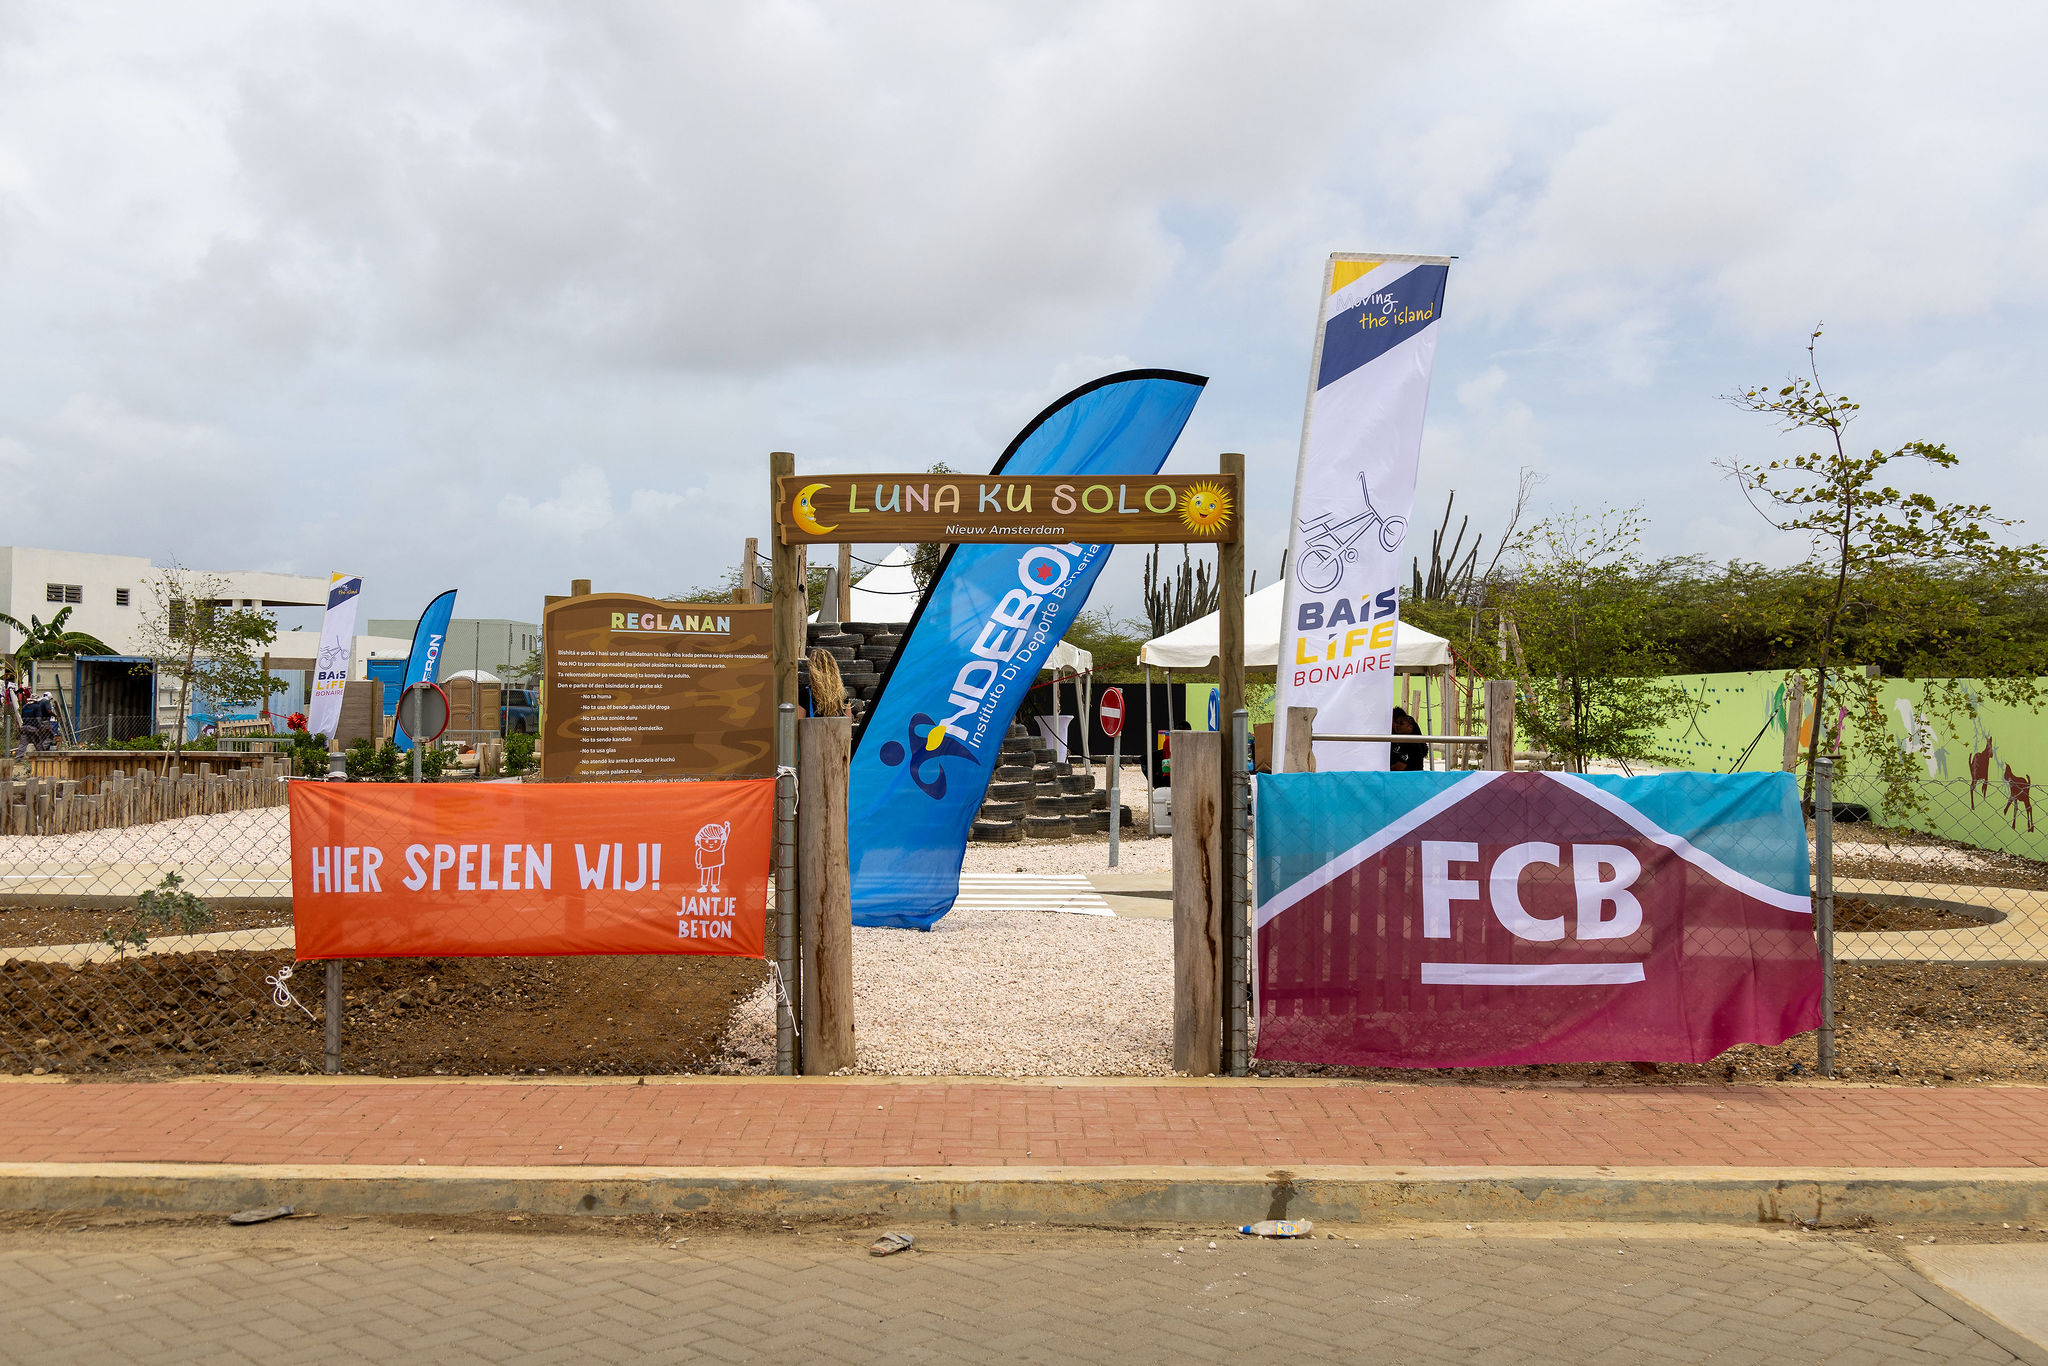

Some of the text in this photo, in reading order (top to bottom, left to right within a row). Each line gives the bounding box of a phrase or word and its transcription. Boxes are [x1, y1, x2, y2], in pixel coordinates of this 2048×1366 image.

[1359, 302, 1434, 330] the island
[848, 484, 1177, 514] LUNA KU SOLO
[945, 524, 1065, 535] Nieuw Amsterdam
[611, 612, 730, 632] REGLANAN
[969, 684, 1006, 748] Instituto
[1002, 664, 1022, 681] Di
[1016, 602, 1059, 663] Deporte
[1294, 653, 1392, 687] BONAIRE
[312, 842, 662, 894] HIER SPELEN WIJ!
[1420, 840, 1644, 942] FCB
[676, 896, 736, 917] JANTJE
[678, 920, 732, 939] BETON
